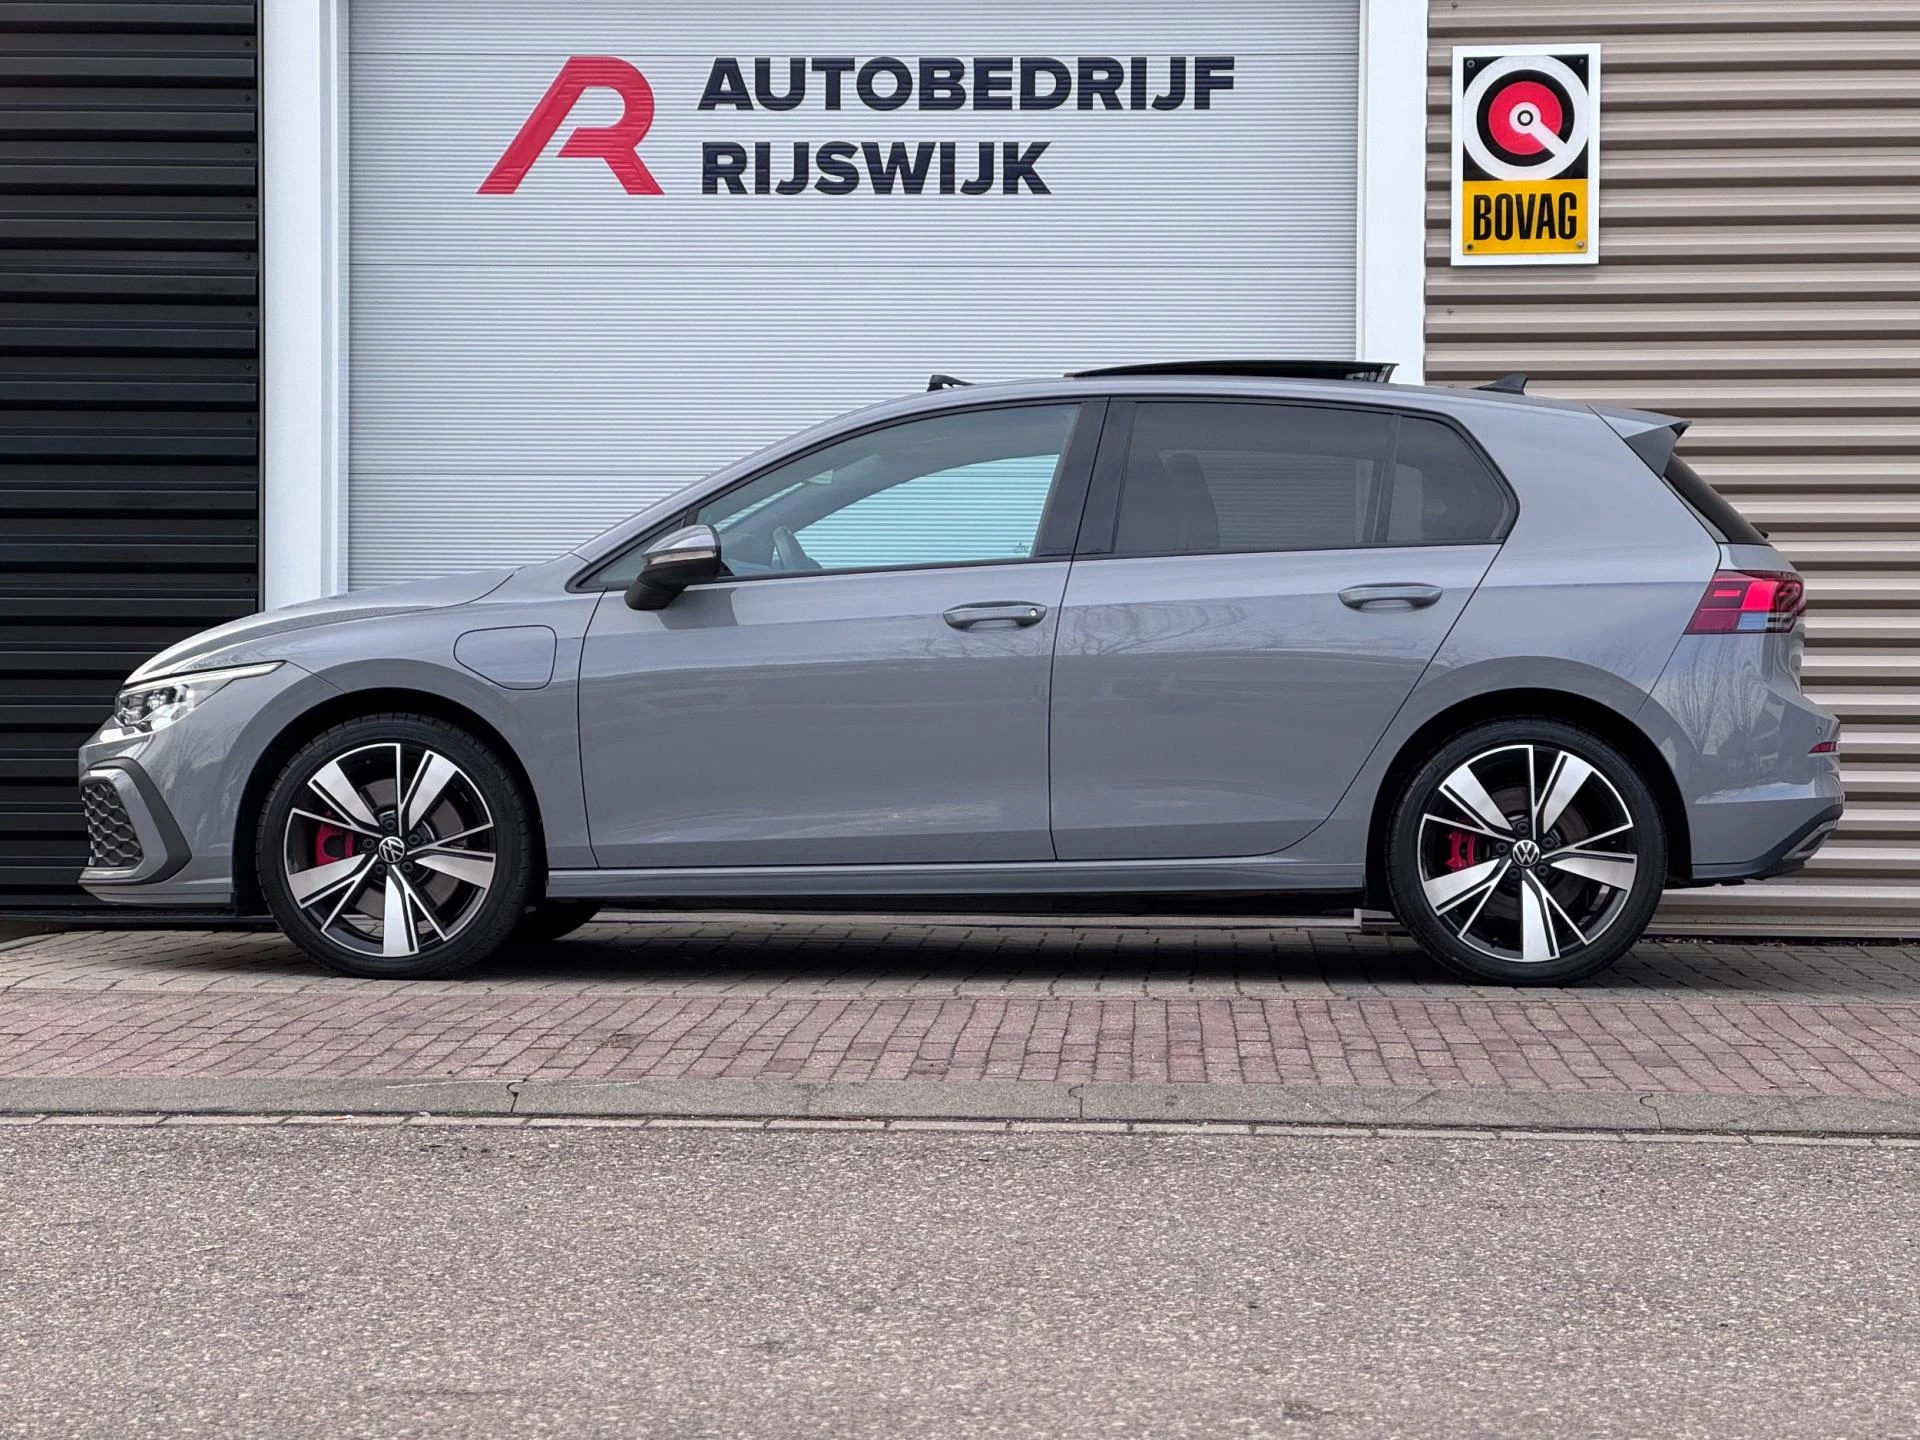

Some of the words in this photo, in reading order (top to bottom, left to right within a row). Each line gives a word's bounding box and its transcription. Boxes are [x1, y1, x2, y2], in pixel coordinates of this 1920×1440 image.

[698, 56, 1234, 111] AUTOBEDRIJF
[703, 142, 1051, 195] RIJSWIJK
[1474, 192, 1577, 241] BOVAG
